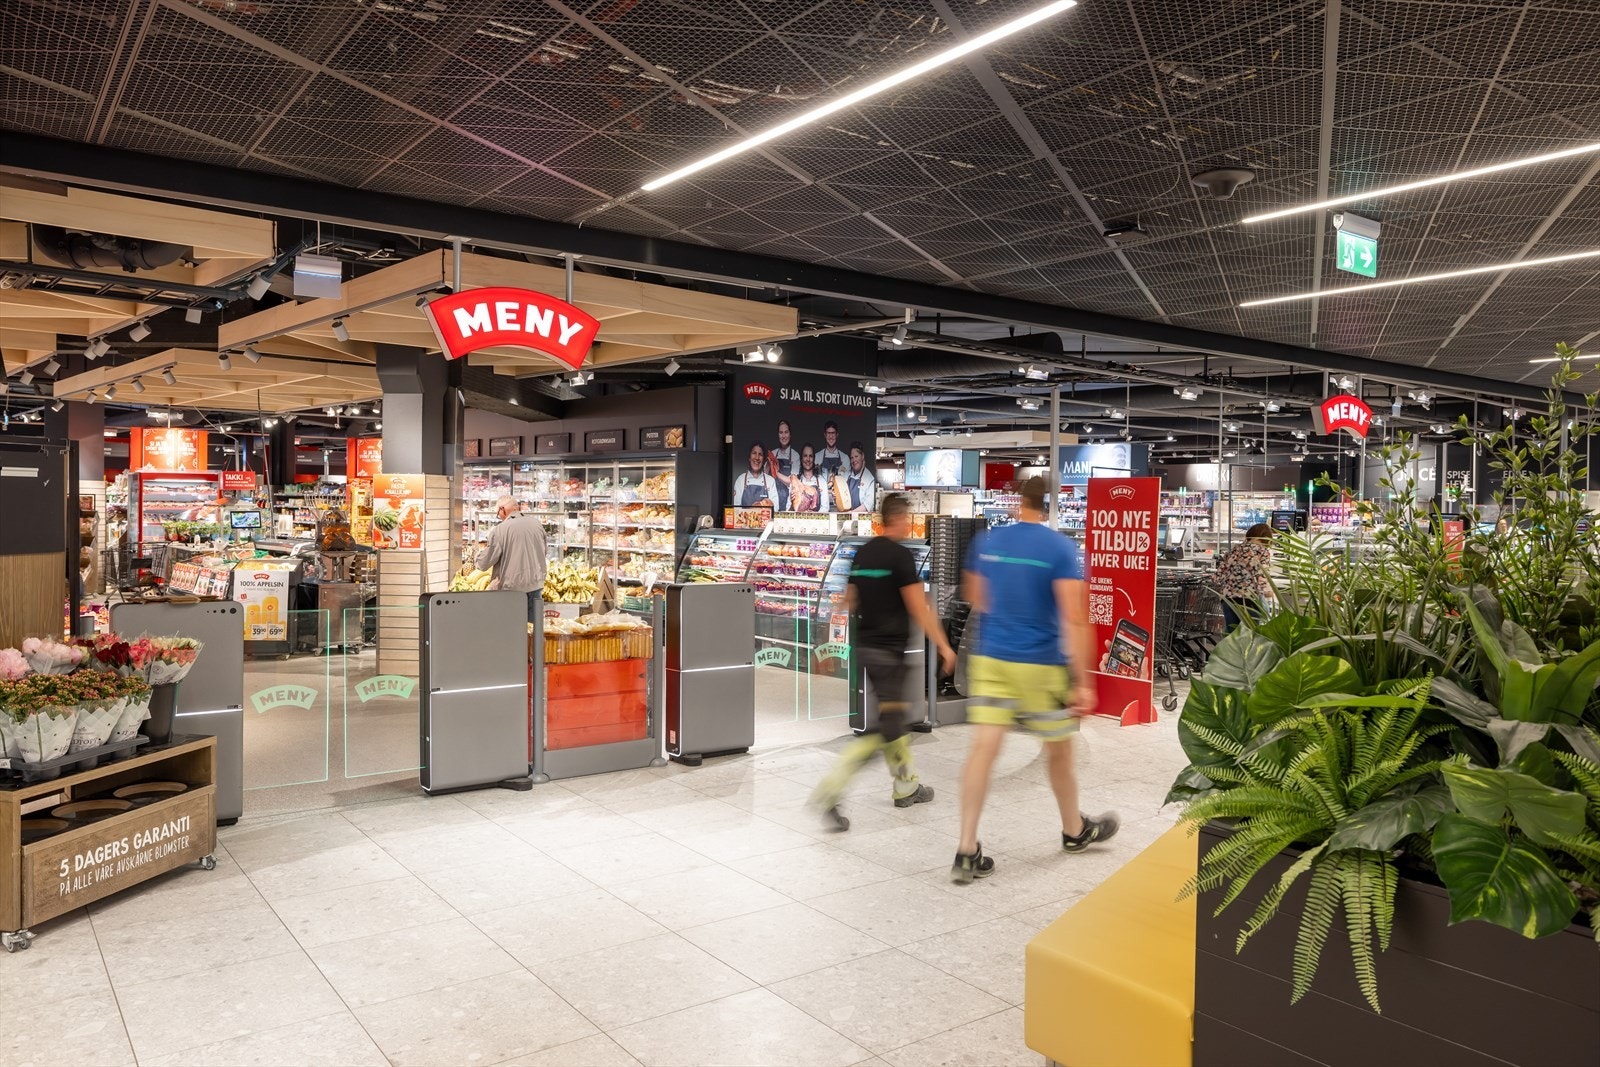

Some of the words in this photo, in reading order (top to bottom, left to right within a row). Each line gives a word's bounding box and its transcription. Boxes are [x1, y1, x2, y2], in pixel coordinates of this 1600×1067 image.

[452, 301, 584, 346] MENY
[746, 385, 770, 396] MENY
[780, 388, 788, 400] SI
[790, 389, 801, 401] JA
[803, 390, 814, 402] TIL
[816, 391, 841, 405] STORT
[843, 394, 872, 408] UTVALG
[1327, 402, 1368, 426] MENY
[1397, 468, 1436, 482] JUCE
[1112, 487, 1133, 496] MENY
[1091, 510, 1118, 528] 100
[1122, 510, 1151, 529] NYE
[1090, 553, 1120, 568] HVER
[1123, 555, 1150, 571] UKE!
[757, 651, 787, 664] MENY
[819, 645, 847, 658] MENY
[362, 679, 409, 696] MENY
[259, 689, 312, 707] MENY
[59, 858, 70, 878] 5
[74, 837, 129, 871] DAGERS
[133, 815, 190, 849] GARANTI
[59, 878, 71, 896] PÅ
[72, 871, 93, 894] ALLE
[95, 864, 114, 884] VÅRE
[116, 849, 153, 875] AVSKÅRNE
[154, 836, 190, 860] BLOMSTER
